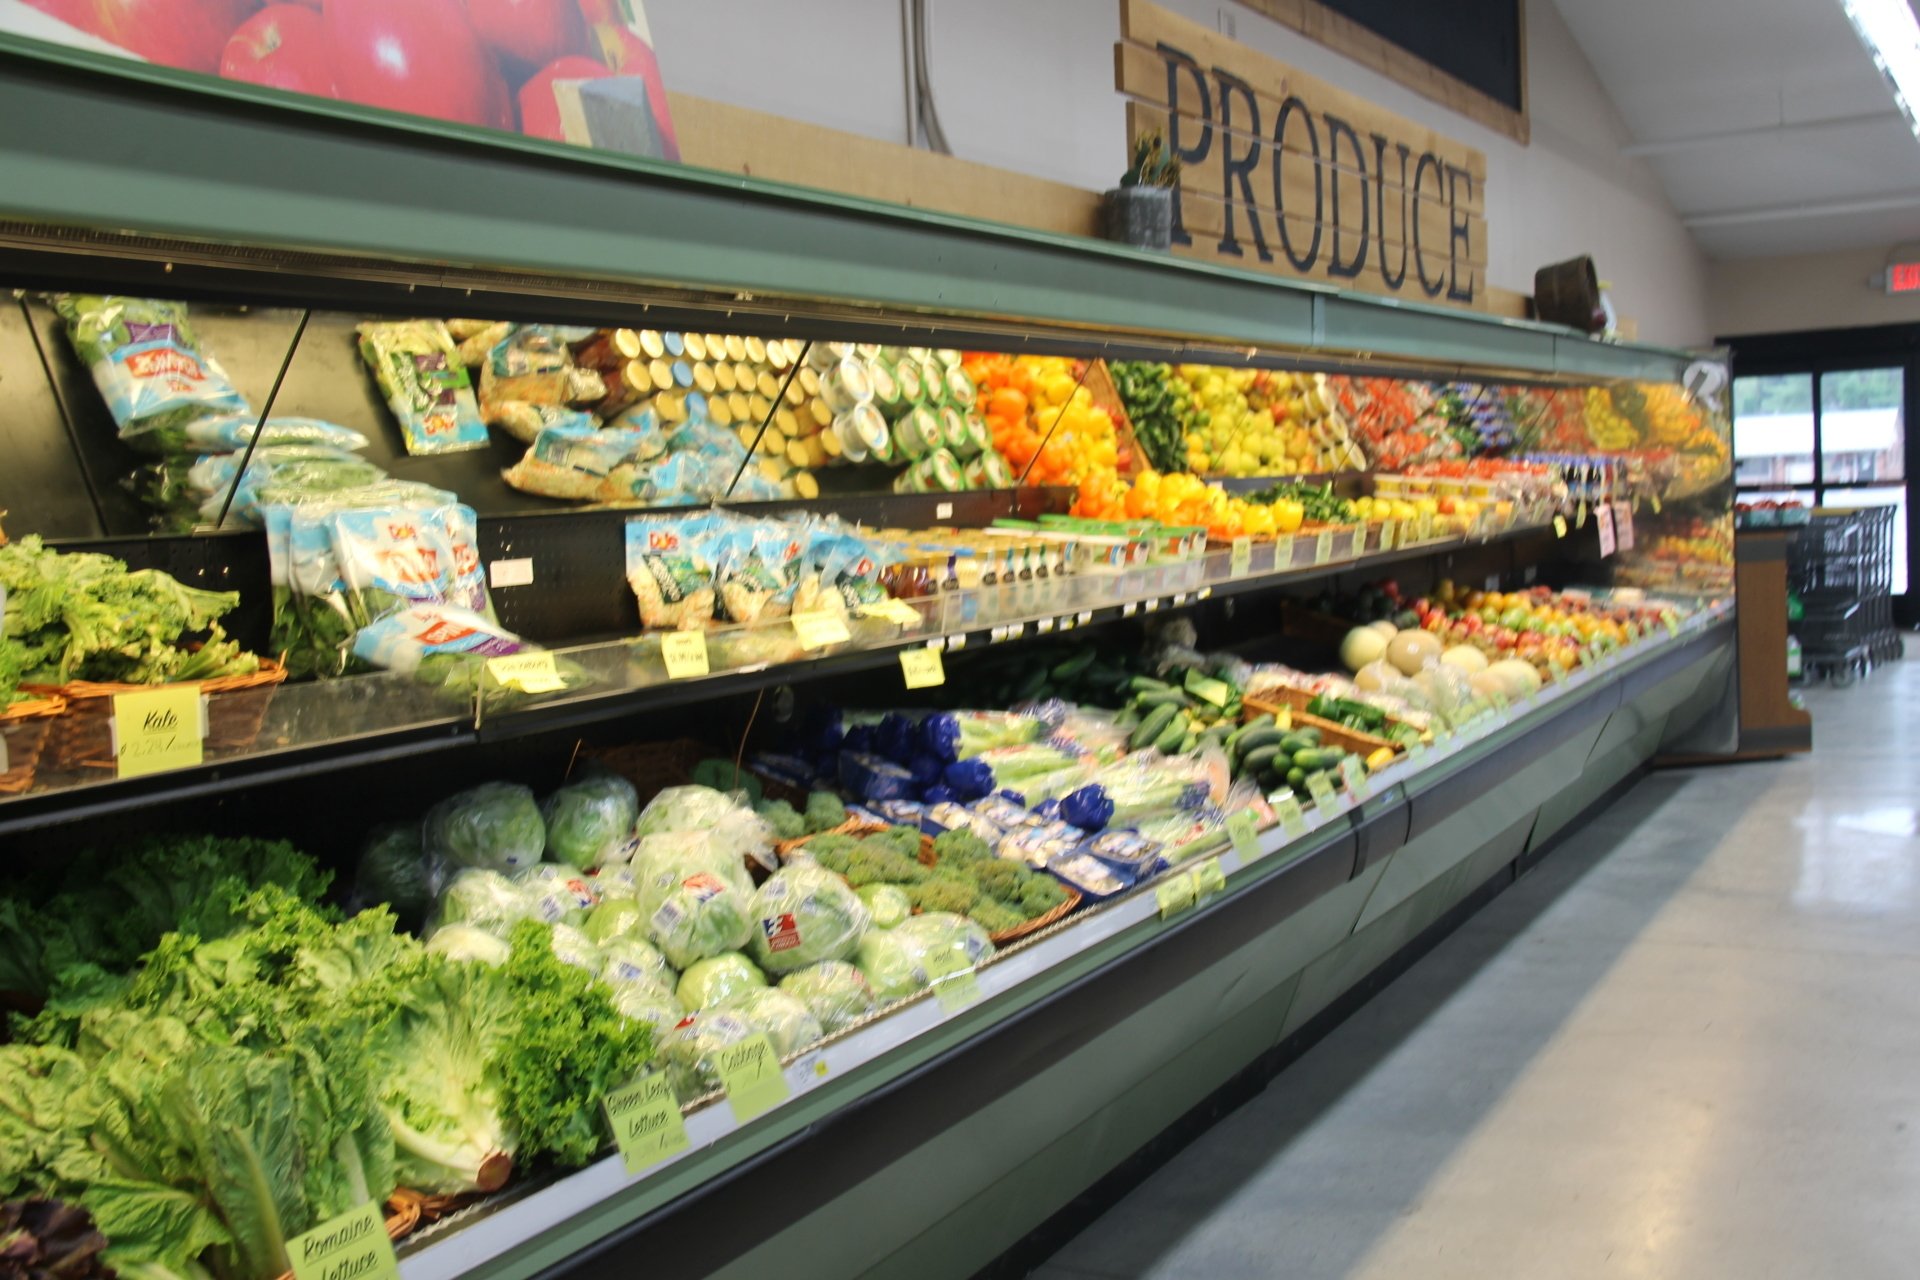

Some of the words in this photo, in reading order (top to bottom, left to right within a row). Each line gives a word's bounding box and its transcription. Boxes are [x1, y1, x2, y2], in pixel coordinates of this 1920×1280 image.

[1156, 39, 1474, 305] PRODUCE
[143, 708, 178, 733] Kale
[303, 1214, 376, 1263] Romaine
